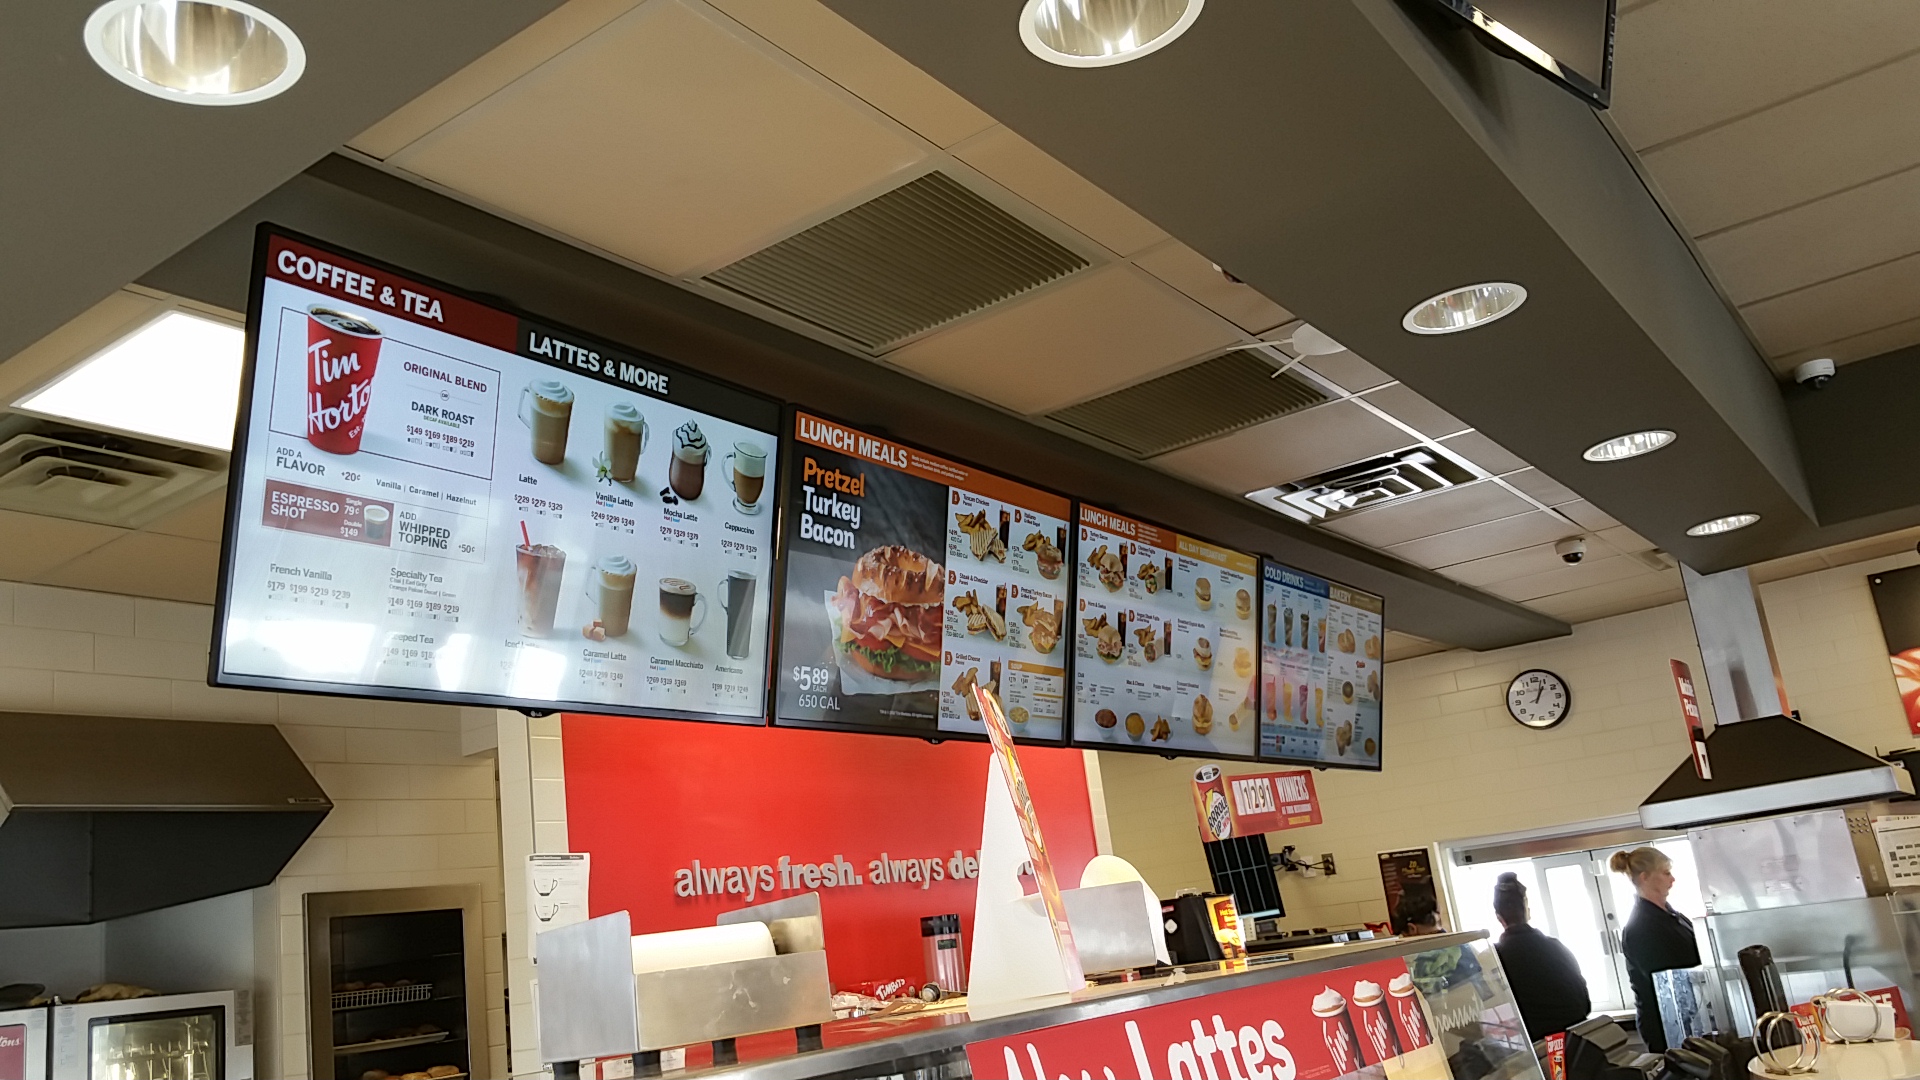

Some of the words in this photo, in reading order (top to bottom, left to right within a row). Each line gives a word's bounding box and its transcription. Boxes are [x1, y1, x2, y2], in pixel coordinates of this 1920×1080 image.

[277, 250, 375, 301] COFFEE
[379, 286, 396, 308] &
[400, 289, 444, 323] TEA
[308, 338, 361, 386] Tim
[529, 331, 601, 372] LATTES
[603, 359, 616, 378] &
[619, 362, 669, 395] MORE
[404, 361, 453, 384] ORIGINAL
[454, 376, 488, 393] BLEND
[411, 401, 440, 417] DARK
[441, 409, 475, 426] ROAST
[799, 417, 855, 452] LUNCH
[857, 438, 908, 469] MEALS
[276, 447, 295, 457] ADD
[296, 451, 302, 459] A
[276, 456, 326, 476] FLAVOR
[518, 473, 538, 486] Latte
[803, 456, 866, 498] Pretzel
[376, 478, 402, 491] Vanilla
[409, 485, 440, 499] Caramel
[446, 493, 477, 506] Hazelnut
[595, 491, 617, 504] Vanilla
[617, 495, 634, 508] Latte
[270, 503, 307, 520] SHOT
[271, 490, 340, 514] ESPRESSO
[802, 485, 861, 530] Turkey
[399, 510, 417, 521] ADD
[663, 507, 682, 519] Mocha
[683, 511, 698, 522] Latte
[1079, 506, 1109, 528] LUNCH
[1109, 516, 1136, 537] MEALS
[399, 521, 451, 539] WHIPPED
[724, 521, 755, 535] Cappuccino
[799, 513, 856, 550] Bacon
[398, 532, 448, 550] TOPPING
[270, 563, 301, 576] French
[303, 568, 333, 581] Vanilla
[390, 567, 427, 583] Specialty
[428, 573, 443, 583] Tea
[1264, 565, 1281, 581] COLD
[1281, 571, 1304, 589] DRINKS
[1329, 586, 1352, 604] BAKERY
[419, 634, 434, 644] Tea
[583, 648, 610, 660] Caramel
[610, 651, 627, 661] Latte
[650, 656, 675, 667] Caramel
[675, 659, 704, 670] Macchiato
[714, 664, 743, 675] Americano
[793, 665, 829, 691] $589
[812, 684, 827, 693] EACH
[1530, 676, 1540, 684] 12
[798, 694, 818, 708] 650
[819, 696, 841, 711] CAL
[1516, 689, 1526, 697] 10
[1274, 775, 1310, 803] WINNERS
[674, 859, 775, 902] always
[778, 855, 864, 890] fresh.
[868, 852, 945, 890] always
[1397, 999, 1421, 1050] Tim
[1363, 1009, 1388, 1062] Tim
[1322, 1019, 1349, 1076] Tim
